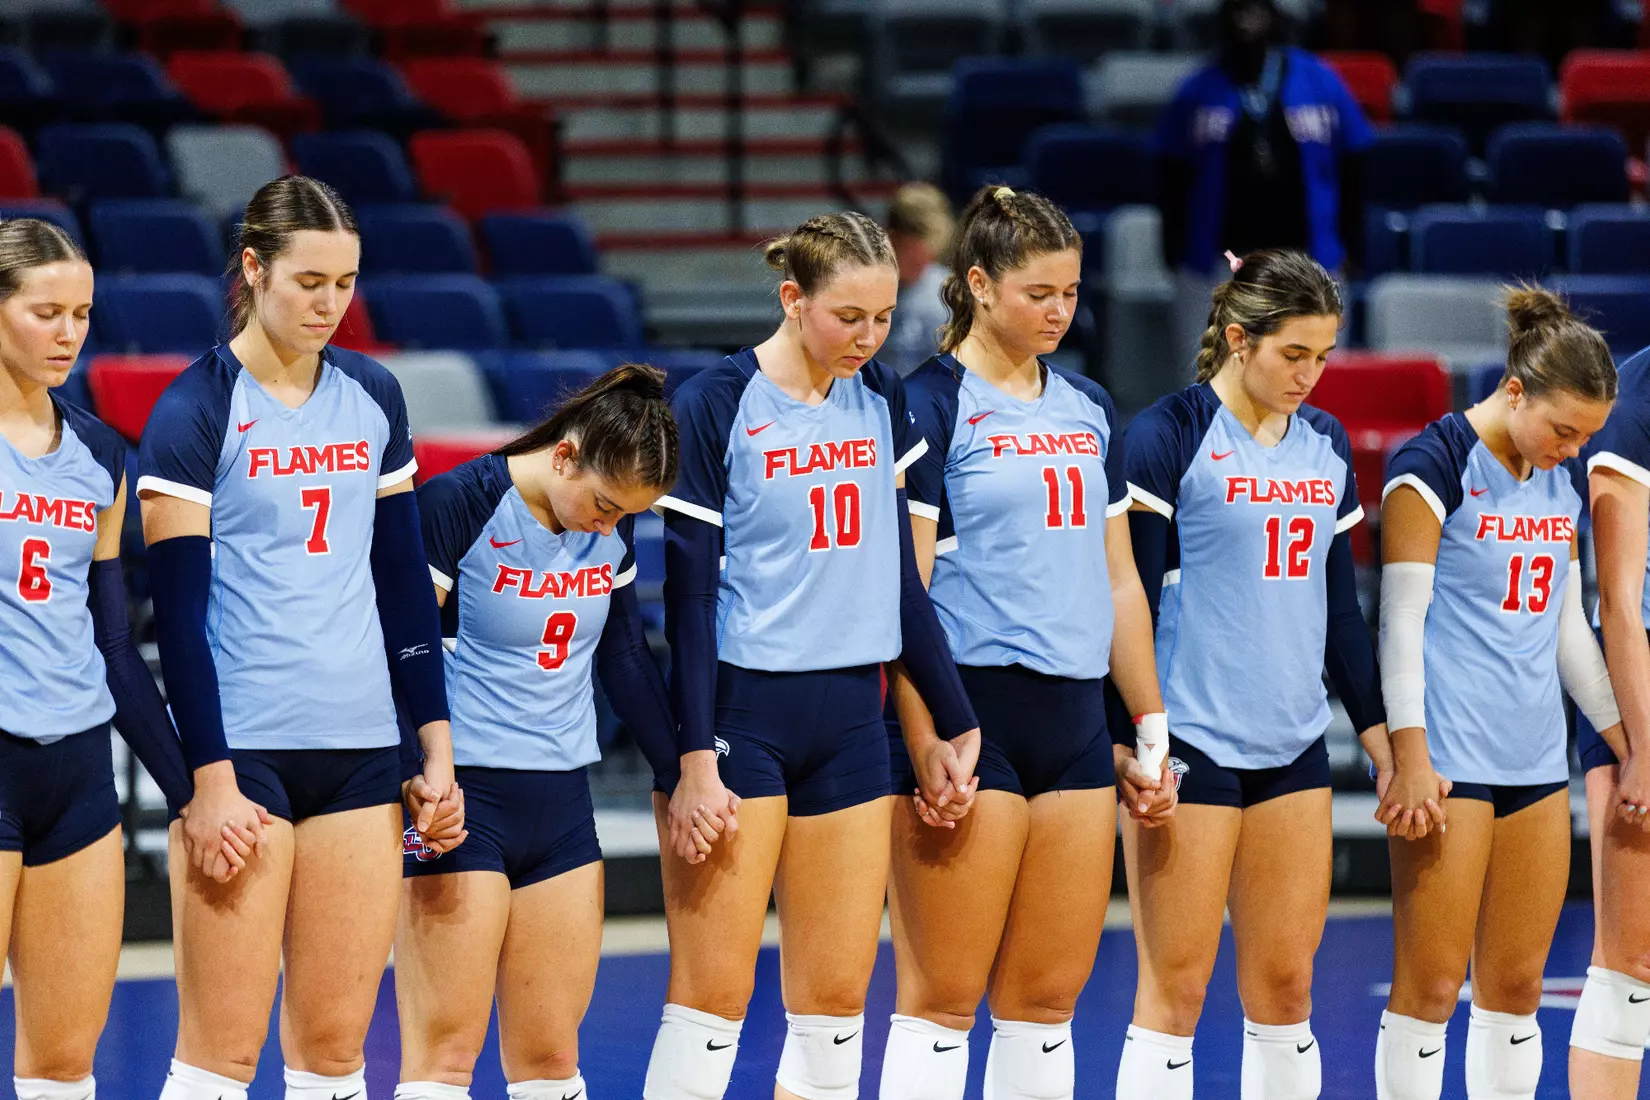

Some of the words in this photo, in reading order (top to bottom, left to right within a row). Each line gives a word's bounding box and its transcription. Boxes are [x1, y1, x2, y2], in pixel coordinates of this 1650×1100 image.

[247, 440, 371, 479] FLAMES
[762, 437, 876, 480] FLAMES
[986, 432, 1099, 458] FLAMES
[300, 484, 332, 556] 7
[808, 480, 862, 553] 10
[1041, 464, 1087, 530] 11
[1224, 475, 1336, 508] FLAMES
[1262, 514, 1316, 580] 12
[1475, 511, 1574, 544] FLAMES
[16, 536, 53, 604] 6
[491, 562, 613, 599] FLAMES
[1500, 552, 1556, 616] 13
[536, 610, 578, 672] 9
